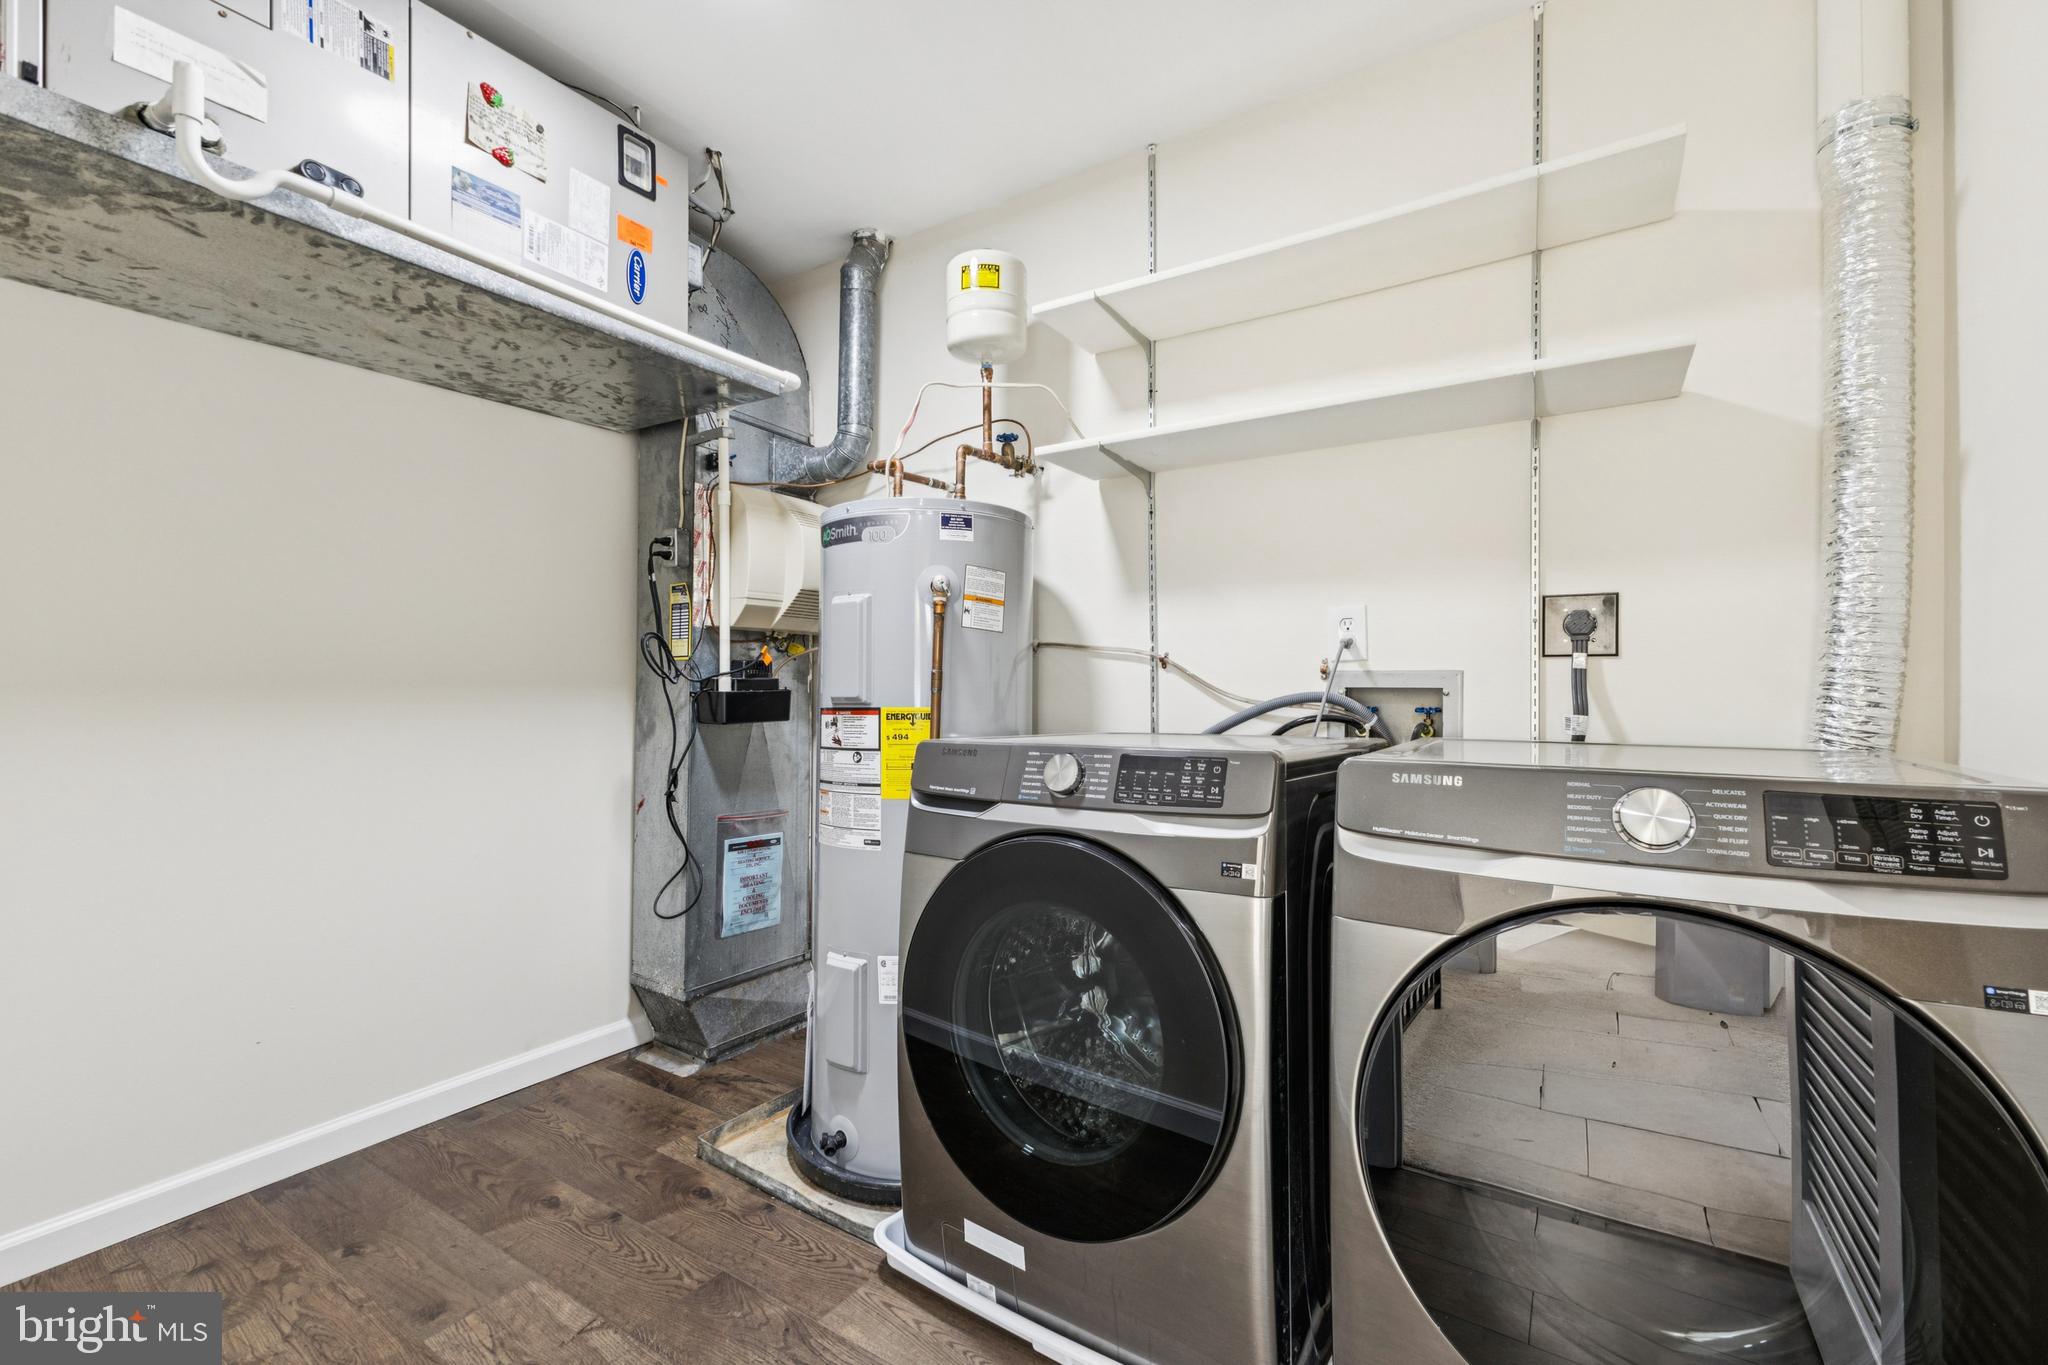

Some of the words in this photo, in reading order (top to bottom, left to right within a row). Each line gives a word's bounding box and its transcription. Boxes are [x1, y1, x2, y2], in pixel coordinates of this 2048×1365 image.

[634, 256, 643, 297] Carrier
[886, 713, 931, 722] ENERGYGUID
[942, 747, 978, 757] SAMSUNG
[1392, 773, 1463, 787] SAMSUNG
[1705, 801, 1747, 809] ACTIVEWEAR
[1713, 813, 1734, 821] QUICK
[1734, 814, 1748, 822] DRY
[1706, 848, 1750, 857] DOWNLOADED
[1773, 849, 1800, 857] Dryness
[739, 872, 768, 883] IMPORTANT
[742, 893, 765, 902] COOLING
[738, 898, 768, 910] DOCUMENTS
